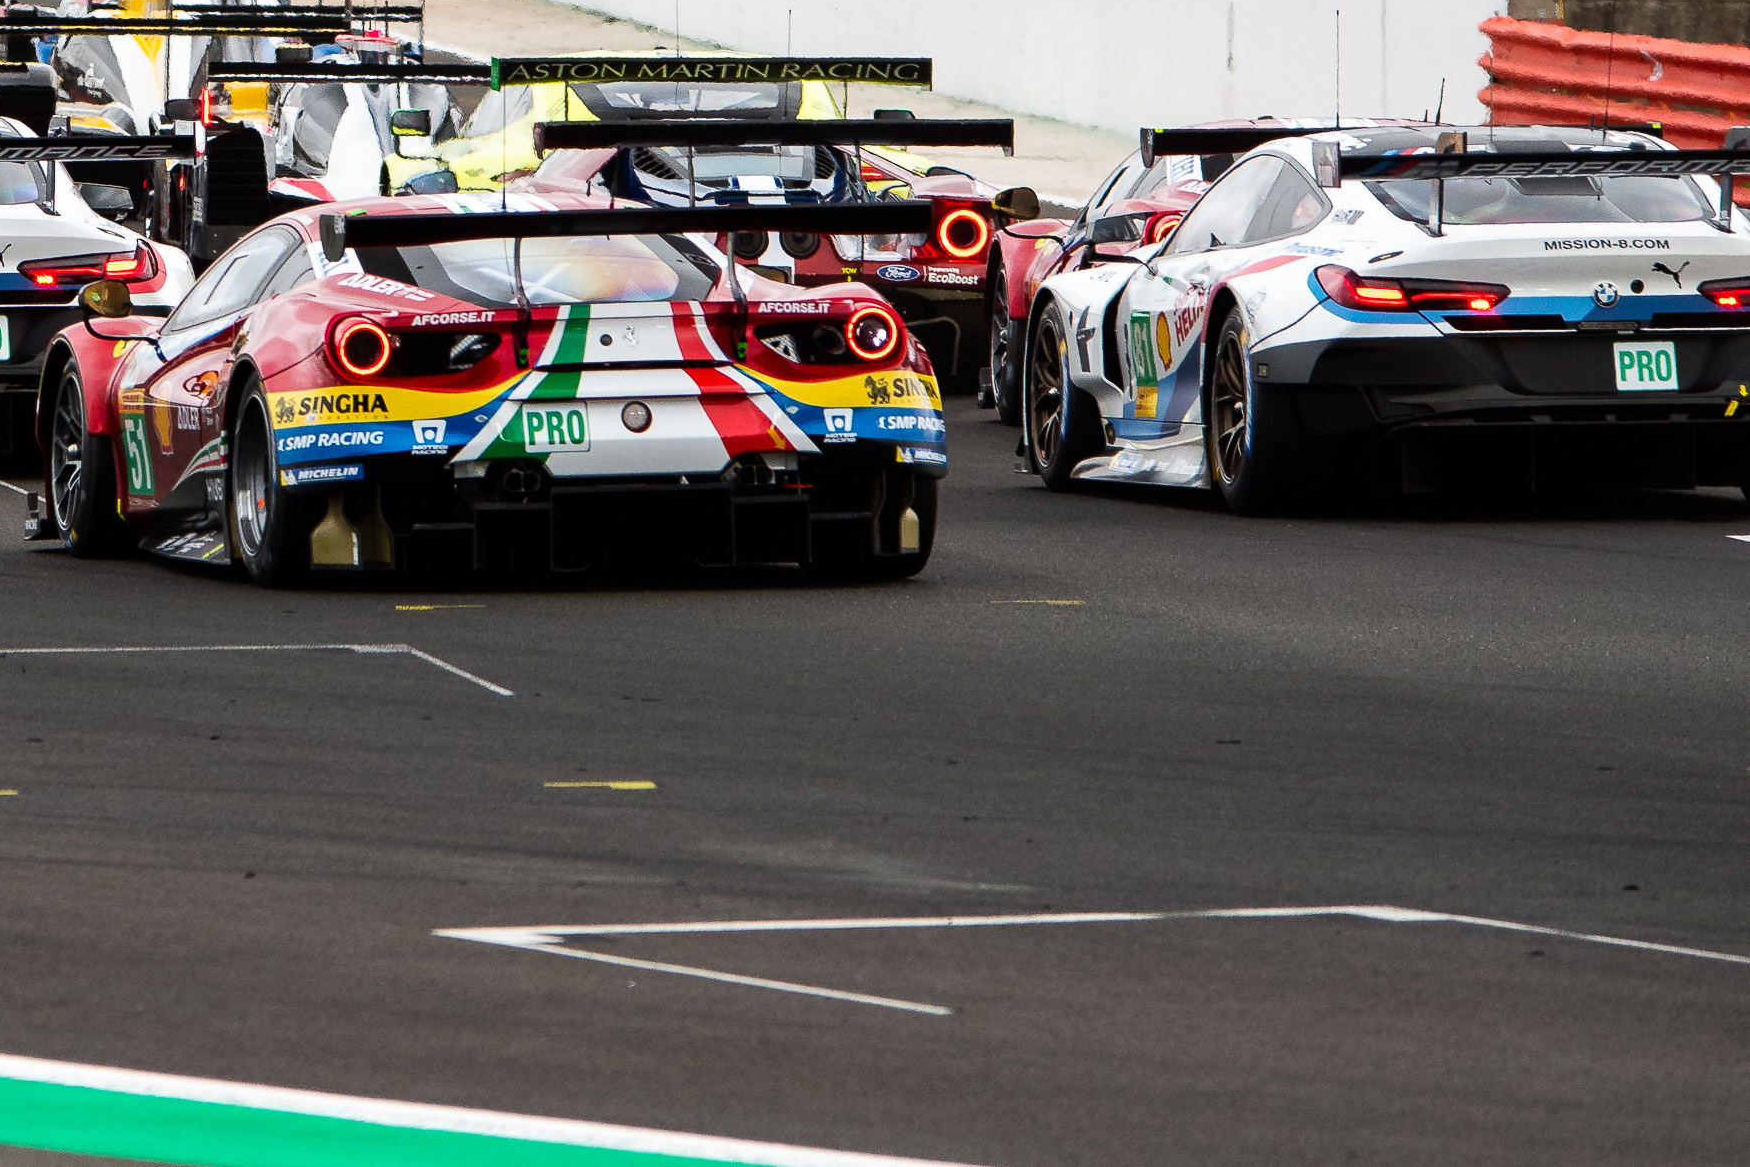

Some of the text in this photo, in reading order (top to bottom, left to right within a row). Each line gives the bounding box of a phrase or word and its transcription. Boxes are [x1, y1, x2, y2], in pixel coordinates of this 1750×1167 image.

[508, 63, 920, 80] ASTON MARTIN RACING
[1543, 239, 1671, 251] MISSION-8.COM
[885, 266, 913, 279] Ford
[928, 272, 979, 285] EcoBoost
[337, 272, 401, 296] ADLER
[757, 302, 831, 314] AFCORSE.IT
[412, 311, 496, 327] AFCORSE.IT
[1617, 349, 1673, 382] PRO
[298, 393, 389, 416] SINGHA
[526, 409, 586, 446] PRO
[887, 415, 917, 430] SMP
[285, 431, 384, 452] SMP RACING
[124, 418, 152, 490] 51
[297, 466, 359, 480] MICHELIN
